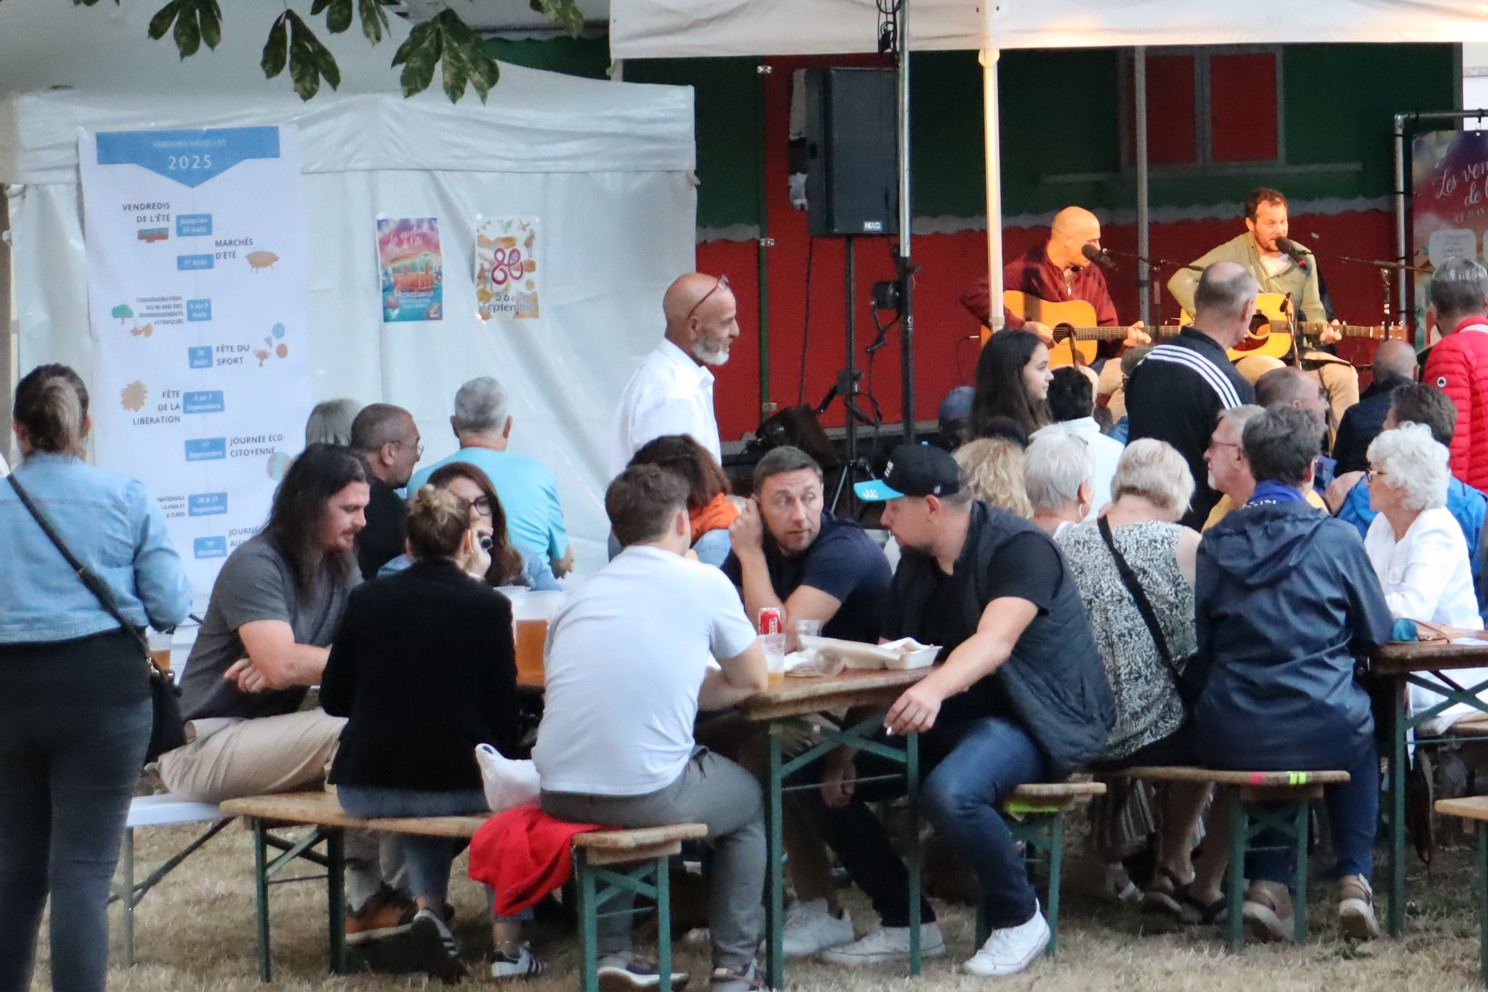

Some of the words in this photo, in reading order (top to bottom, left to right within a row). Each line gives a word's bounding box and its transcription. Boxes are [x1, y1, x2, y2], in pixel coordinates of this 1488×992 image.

[168, 155, 213, 170] 2025
[1431, 168, 1458, 199] Les
[1464, 183, 1482, 206] de
[122, 202, 171, 212] VENDREDIS
[136, 215, 148, 223] DE
[150, 214, 171, 223] L'ÉTÉ
[215, 238, 254, 248] MARCHÉS
[215, 251, 237, 260] D'ÉTÉ
[216, 344, 234, 353] FÊTE
[237, 345, 250, 353] DU
[216, 357, 244, 366] SPORT
[162, 390, 180, 399] FÊTE
[158, 404, 169, 412] DE
[170, 403, 181, 411] LA
[132, 415, 181, 425] LIBÉRATION
[229, 434, 267, 447] JOURNÉE
[230, 446, 275, 457] CITOYENNE
[228, 525, 260, 538] JOURNÉ
